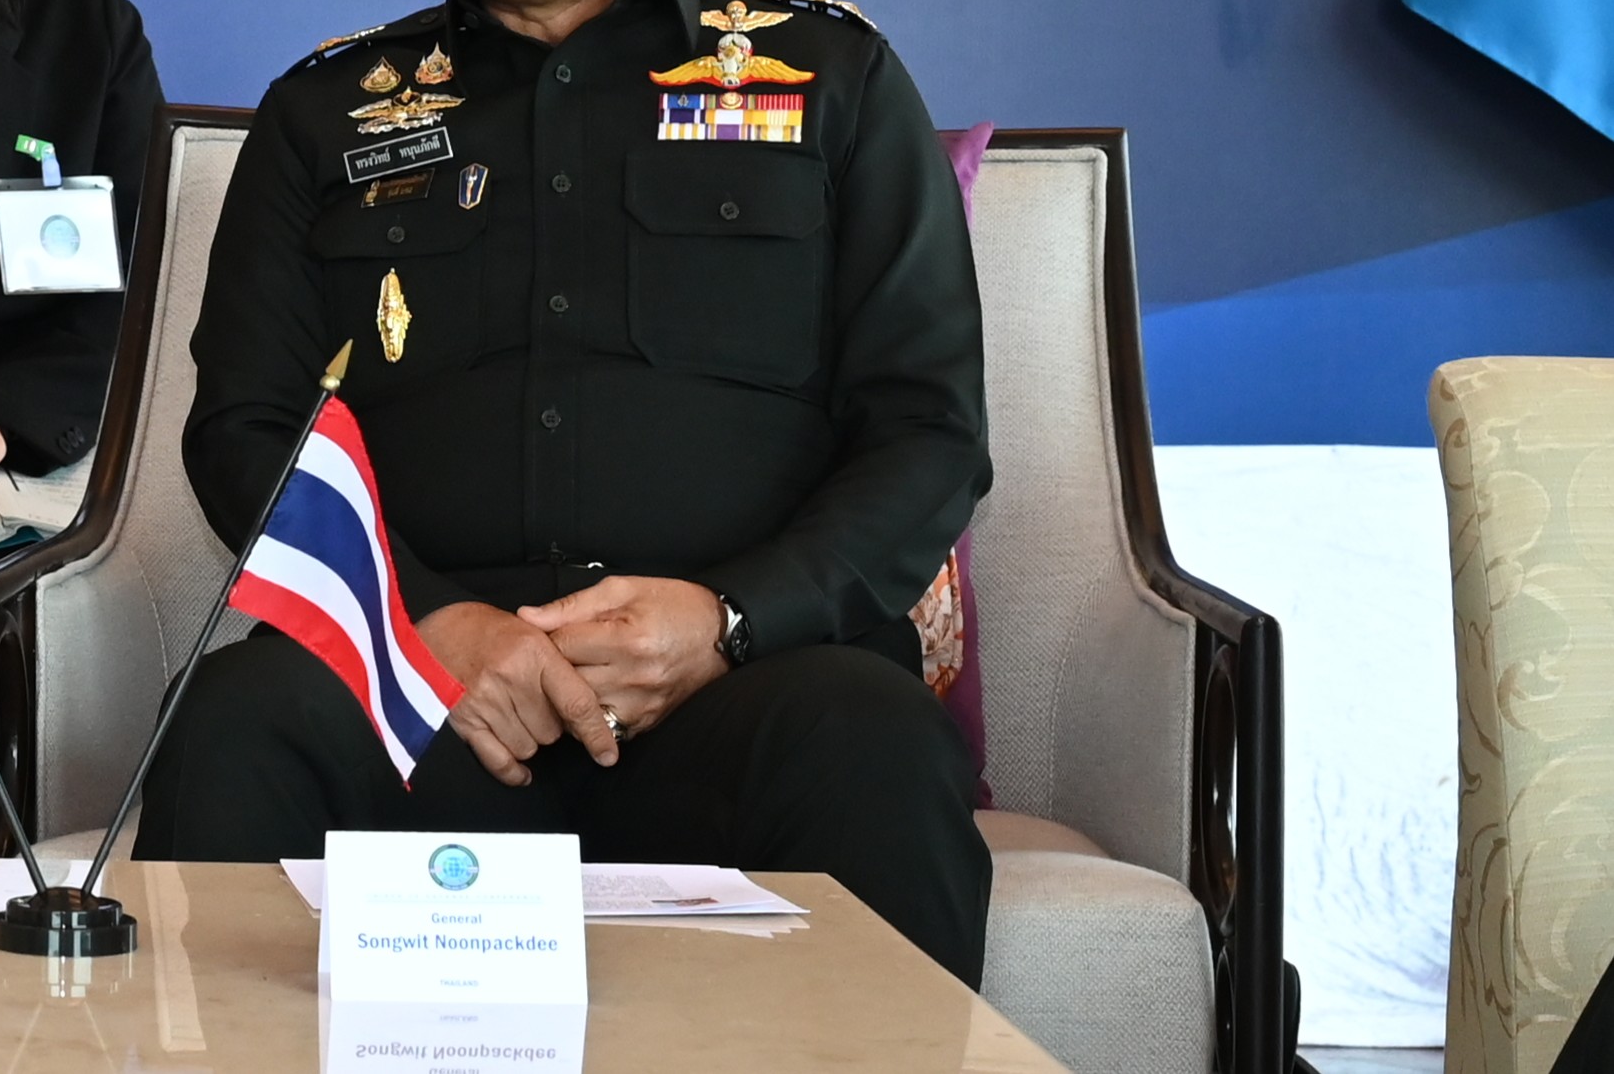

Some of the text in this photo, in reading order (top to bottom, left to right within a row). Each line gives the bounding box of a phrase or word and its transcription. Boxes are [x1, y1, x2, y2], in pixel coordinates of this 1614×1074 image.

[430, 912, 483, 925] General
[357, 932, 558, 954] Songwit Noonpackdee
